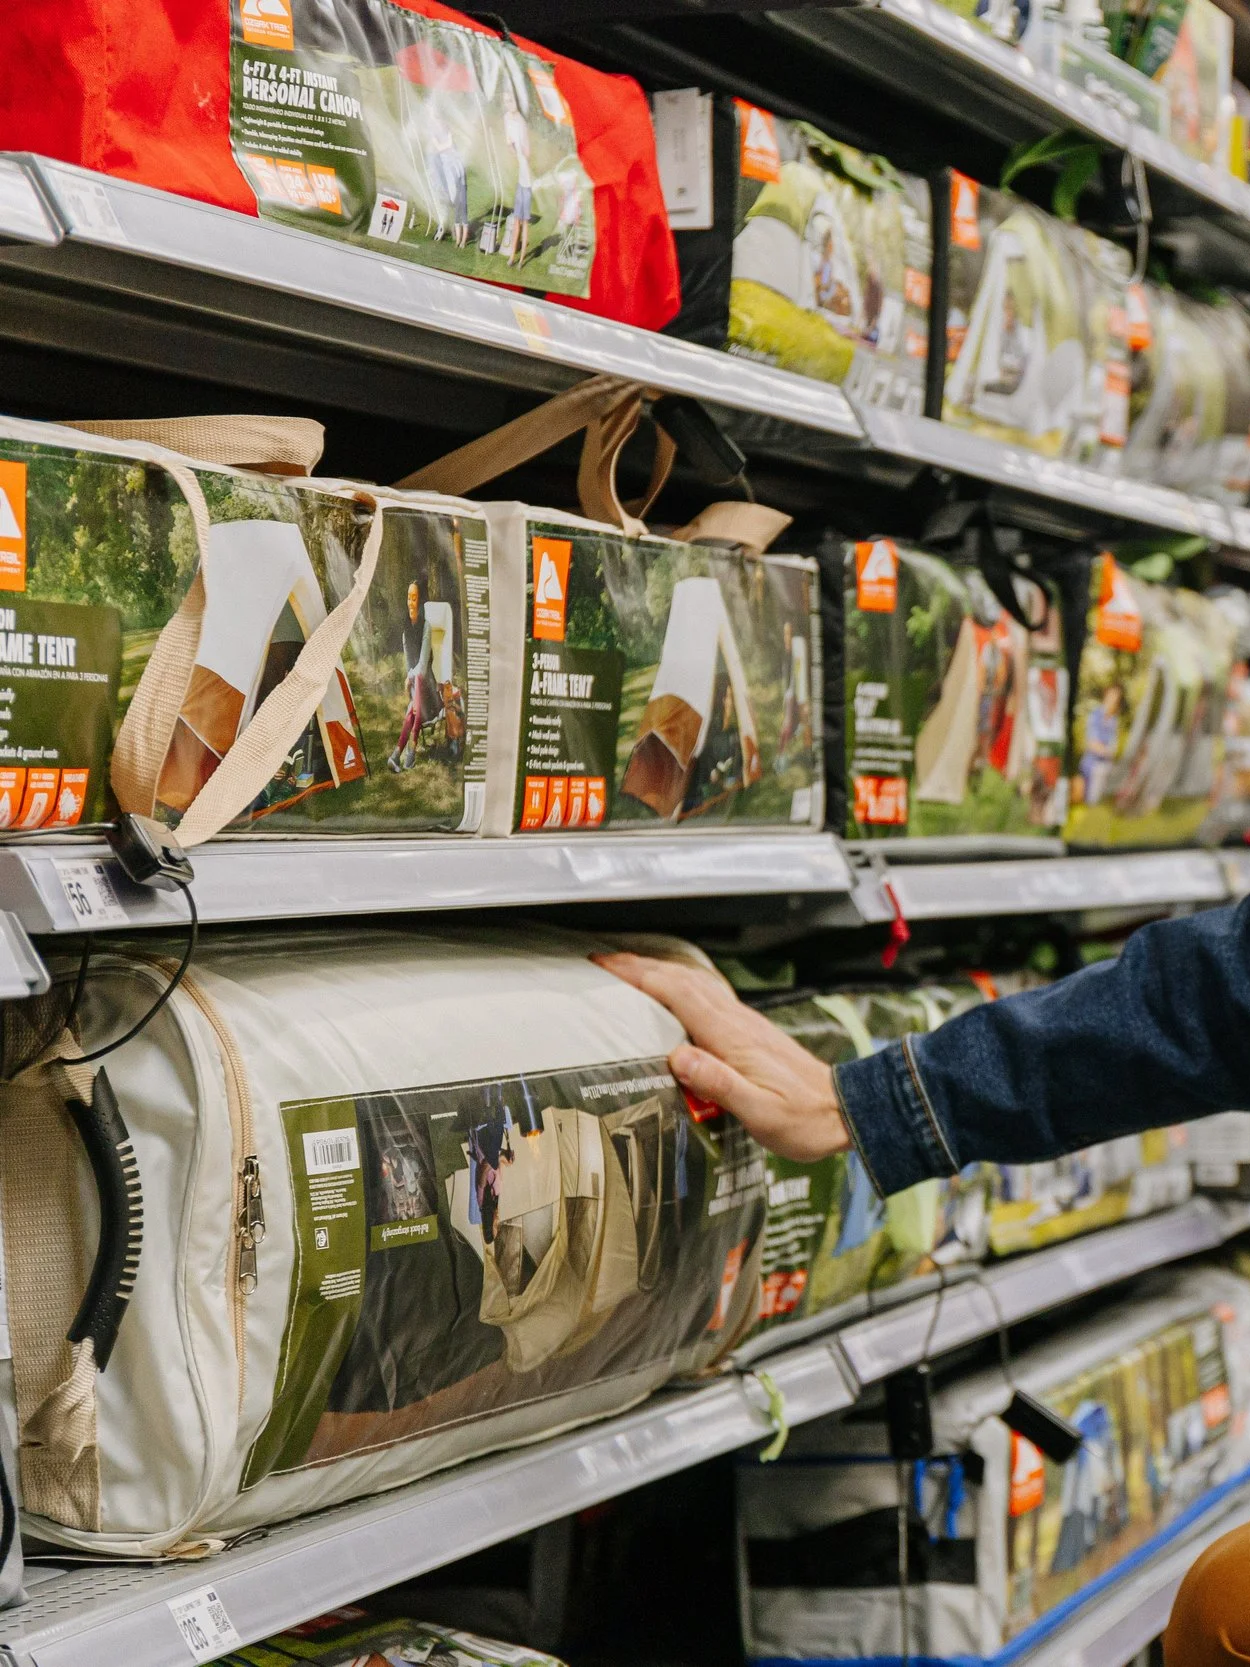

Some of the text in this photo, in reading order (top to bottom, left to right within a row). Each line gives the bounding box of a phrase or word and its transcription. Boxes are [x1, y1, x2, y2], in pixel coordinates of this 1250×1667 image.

[243, 60, 338, 92] 6-FT X 4-FT INSTANT
[243, 76, 316, 110] PERSONAL
[37, 634, 77, 668] TENT
[530, 670, 595, 699] A-FRAME TENT
